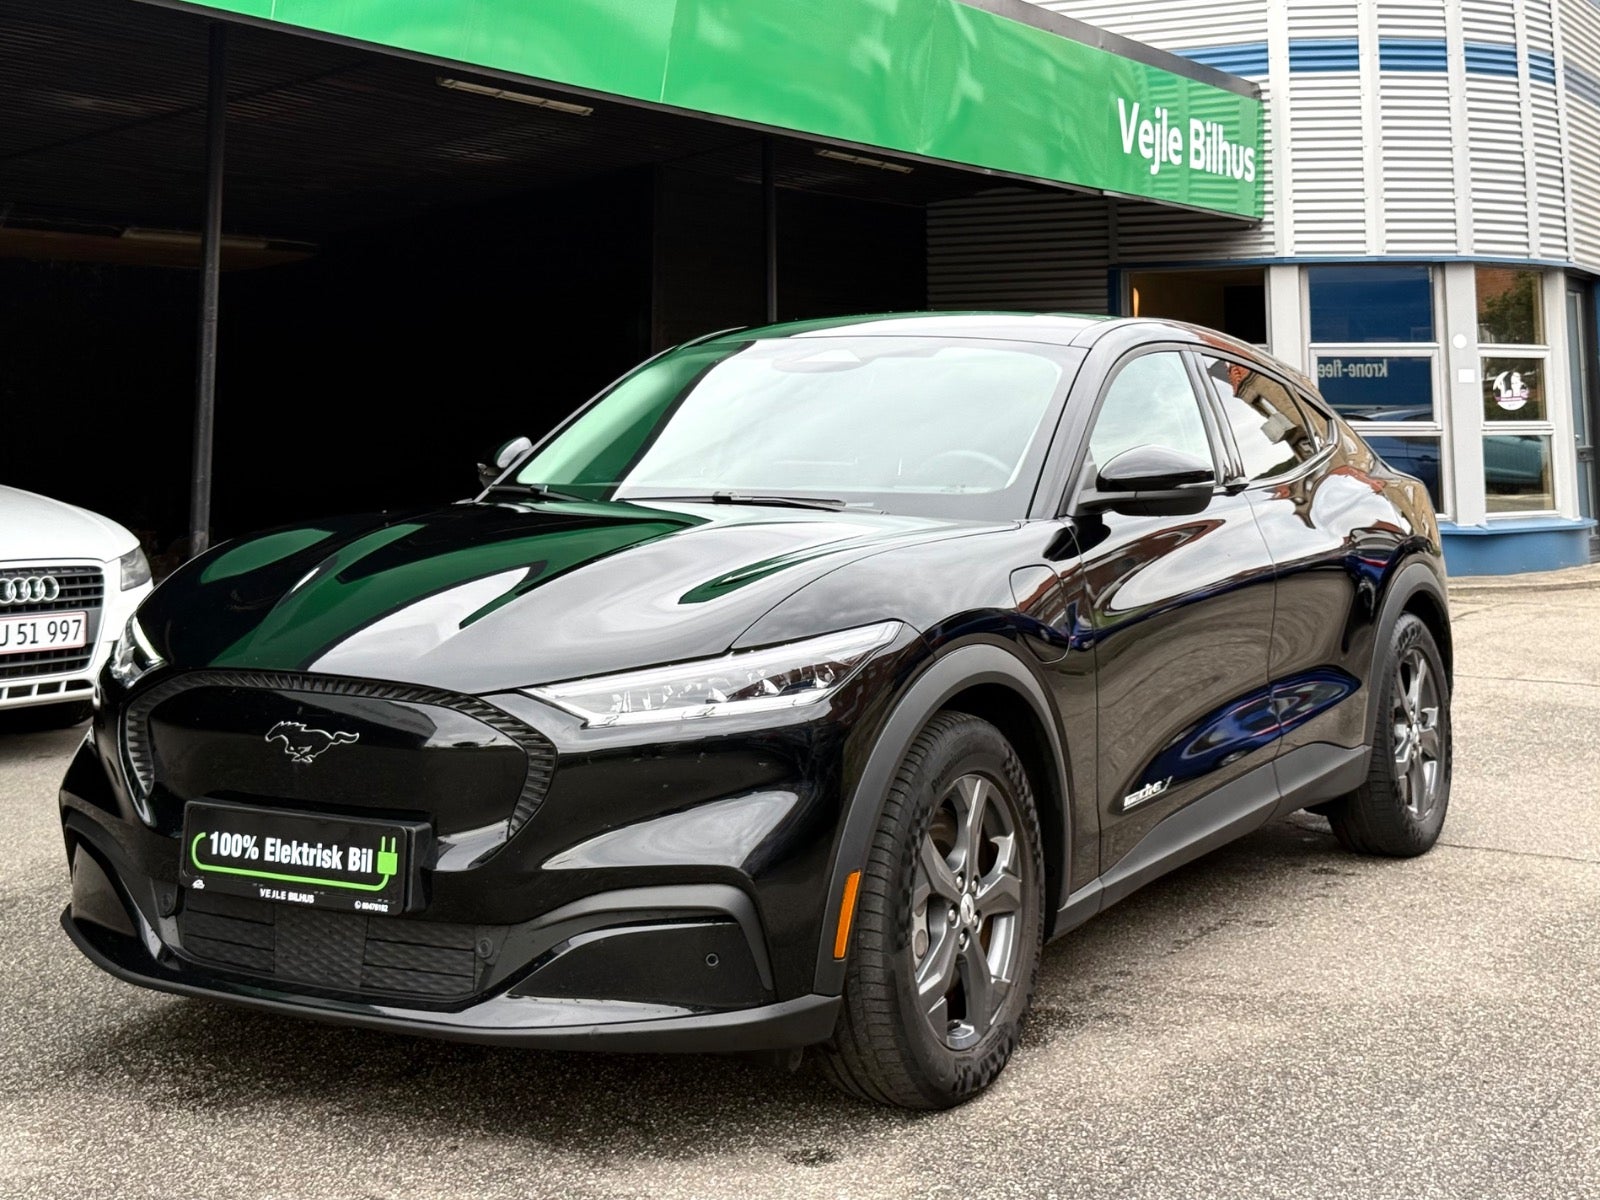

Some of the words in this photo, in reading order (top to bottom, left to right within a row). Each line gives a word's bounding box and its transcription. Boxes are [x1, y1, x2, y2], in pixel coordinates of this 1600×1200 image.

[1118, 98, 1183, 175] Vejle
[1189, 118, 1255, 182] Bilhus
[17, 623, 39, 645] 51
[47, 619, 82, 643] 997
[210, 831, 259, 860] 100%
[264, 837, 343, 870] Elektrisk
[348, 847, 373, 873] Bil
